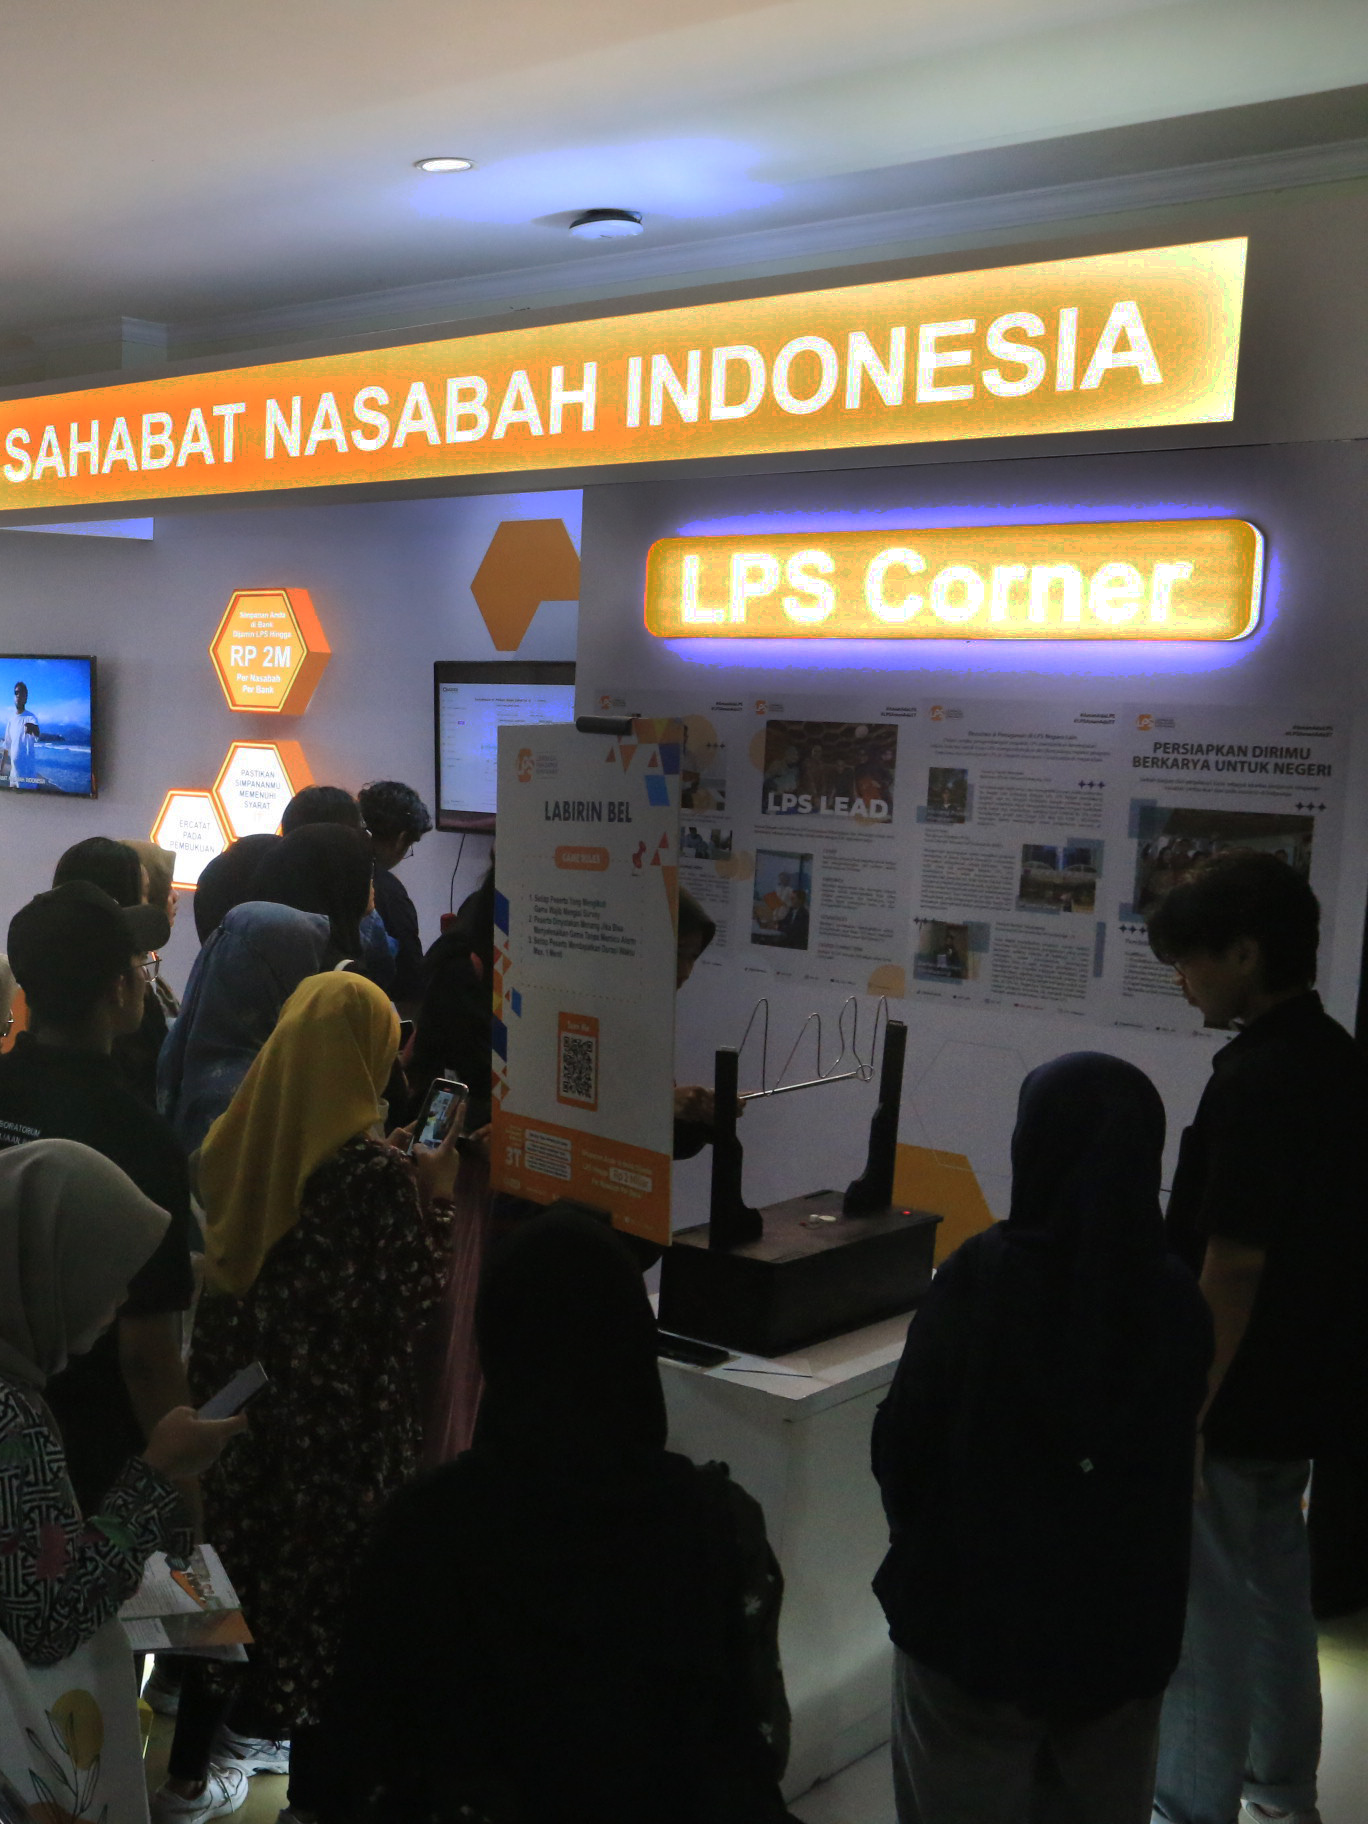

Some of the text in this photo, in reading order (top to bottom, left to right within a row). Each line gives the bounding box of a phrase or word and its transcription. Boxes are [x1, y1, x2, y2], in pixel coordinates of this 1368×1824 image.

[3, 300, 1163, 483] SAHABAT NASABAH INDONESIA
[680, 546, 1194, 626] LPS Corner
[256, 630, 268, 638] LPS
[230, 645, 291, 668] RP 2M
[236, 673, 281, 683] Per Nasabah
[242, 685, 274, 694] Per Bank
[1152, 741, 1311, 760] PERSIAPKAN DIRIMU
[1132, 755, 1332, 777] BERKARYA UNTUK NEGERI
[240, 769, 275, 778] PASTIKAN
[235, 780, 281, 789] SIMPANANMU
[239, 790, 277, 800] MEMENUHI
[244, 801, 270, 810] SYARAT
[767, 792, 889, 819] LPS LEAD
[544, 800, 632, 823] LABIRIN BEL
[179, 820, 211, 830] ERCATAT
[183, 831, 202, 841] PADA
[169, 841, 215, 853] PEMBUKUAN
